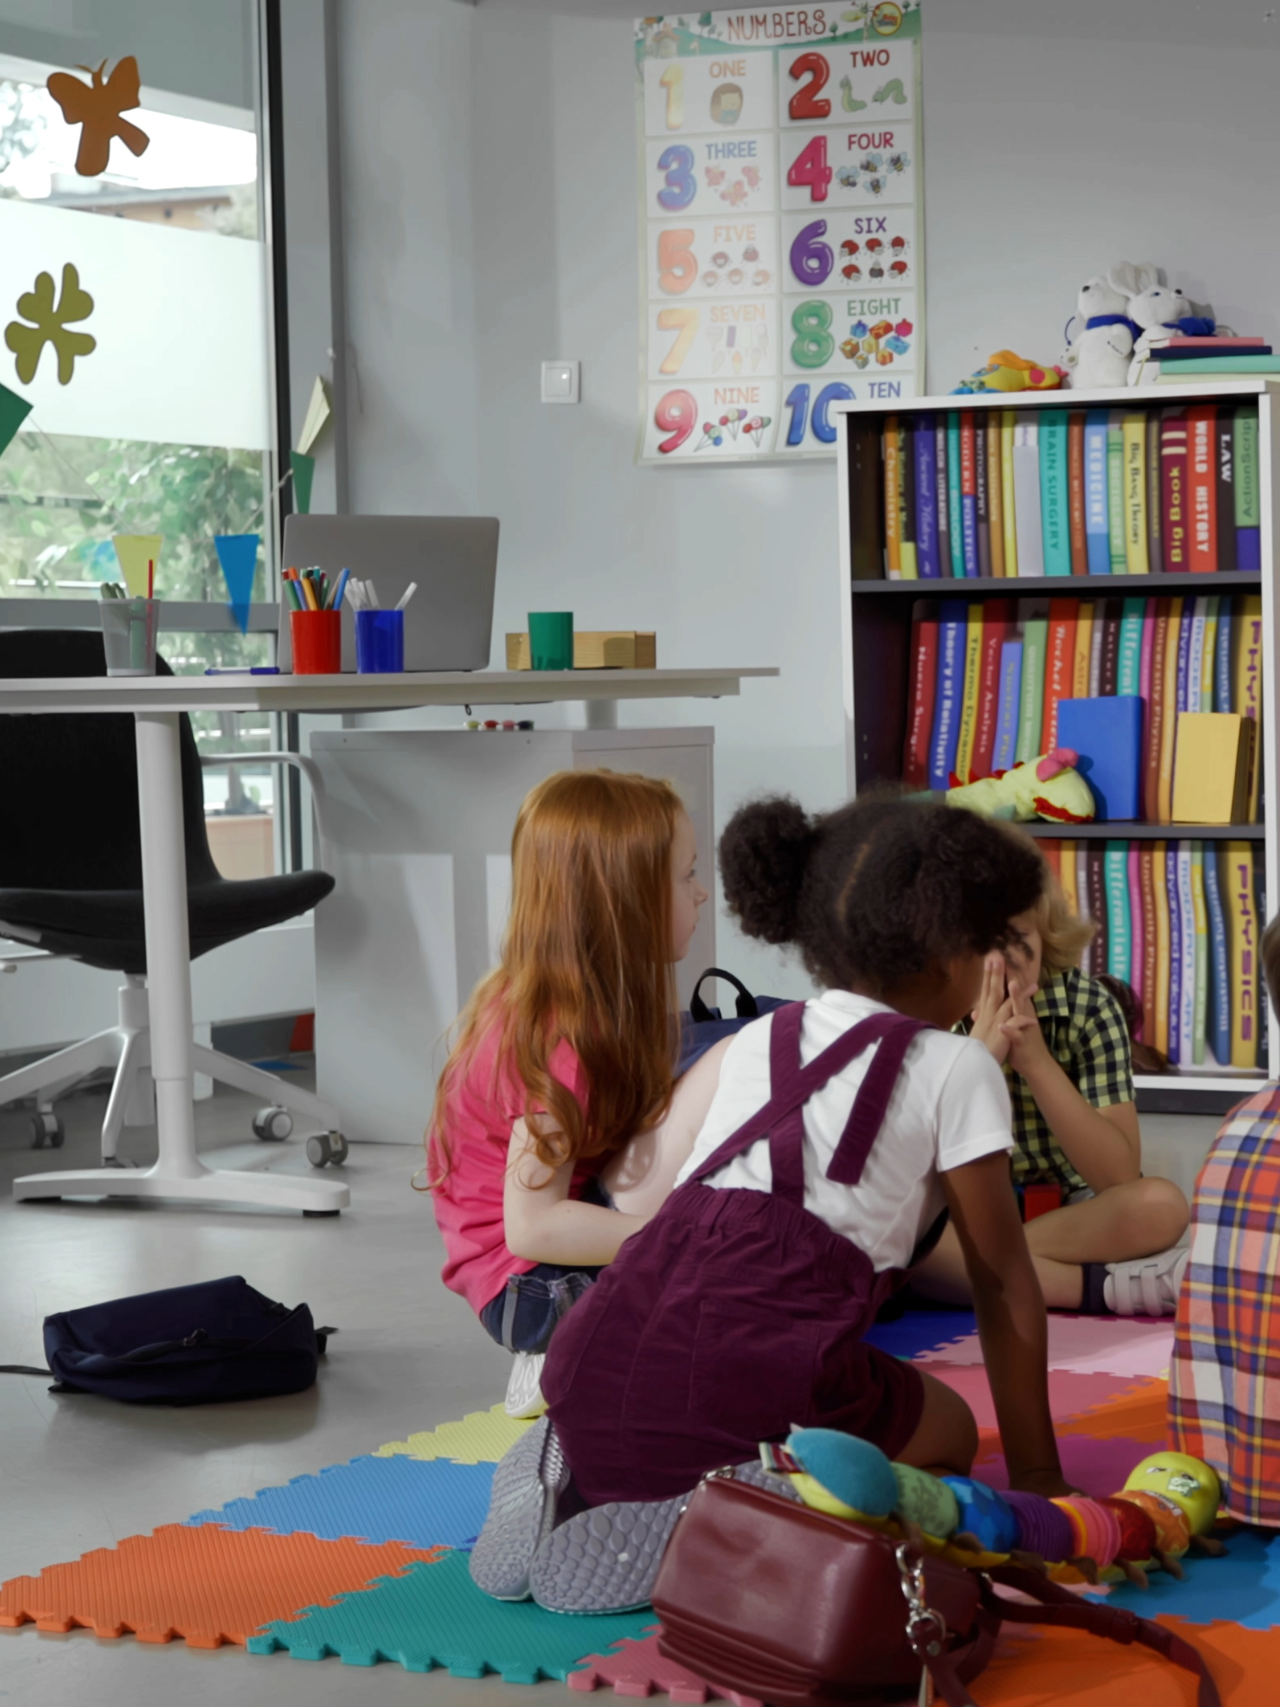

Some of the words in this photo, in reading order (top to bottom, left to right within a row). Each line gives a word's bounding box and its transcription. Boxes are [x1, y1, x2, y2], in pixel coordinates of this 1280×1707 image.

[727, 9, 827, 41] NUMBERS
[709, 60, 746, 78] ONE
[788, 52, 832, 120] 2
[850, 49, 890, 68] TWO
[660, 64, 683, 130] 1
[705, 140, 757, 160] THREE
[787, 135, 832, 202] 4
[847, 132, 894, 151] FOUR
[657, 144, 697, 212] 3
[713, 225, 756, 242] FIVE
[790, 218, 834, 286] 6
[854, 217, 887, 235] SIX
[657, 228, 698, 295] 5
[710, 304, 765, 322] SEVEN
[791, 299, 835, 369] 8
[847, 298, 901, 317] EIGHT
[657, 307, 701, 375] 7
[654, 389, 698, 454] 9
[714, 387, 759, 405] NINE
[868, 381, 901, 399] TEN
[976, 430, 985, 515] PHOTOGRAPHY
[1047, 419, 1057, 470] BRAIN
[1195, 421, 1208, 473] WORLD
[1221, 434, 1231, 482] LAW
[887, 447, 895, 538] Chemistry
[1090, 436, 1103, 523] MEDICINE
[1169, 466, 1181, 521] Book
[963, 498, 974, 570] POLITICS
[1048, 475, 1059, 549] SURGERY
[1196, 486, 1209, 552] HISTORY
[1171, 527, 1183, 562] Big
[944, 622, 957, 676] Theory
[986, 638, 997, 686] Vector
[1153, 617, 1166, 701] University
[944, 679, 953, 696] of
[934, 699, 952, 777] Relativity
[979, 691, 993, 753] Analysis
[1151, 705, 1162, 768] Physics
[1208, 870, 1224, 942] Tutorials
[1146, 946, 1155, 1010] Physics
[1237, 864, 1252, 1041] PHYSICS
[1218, 946, 1229, 1031] Illustrator
